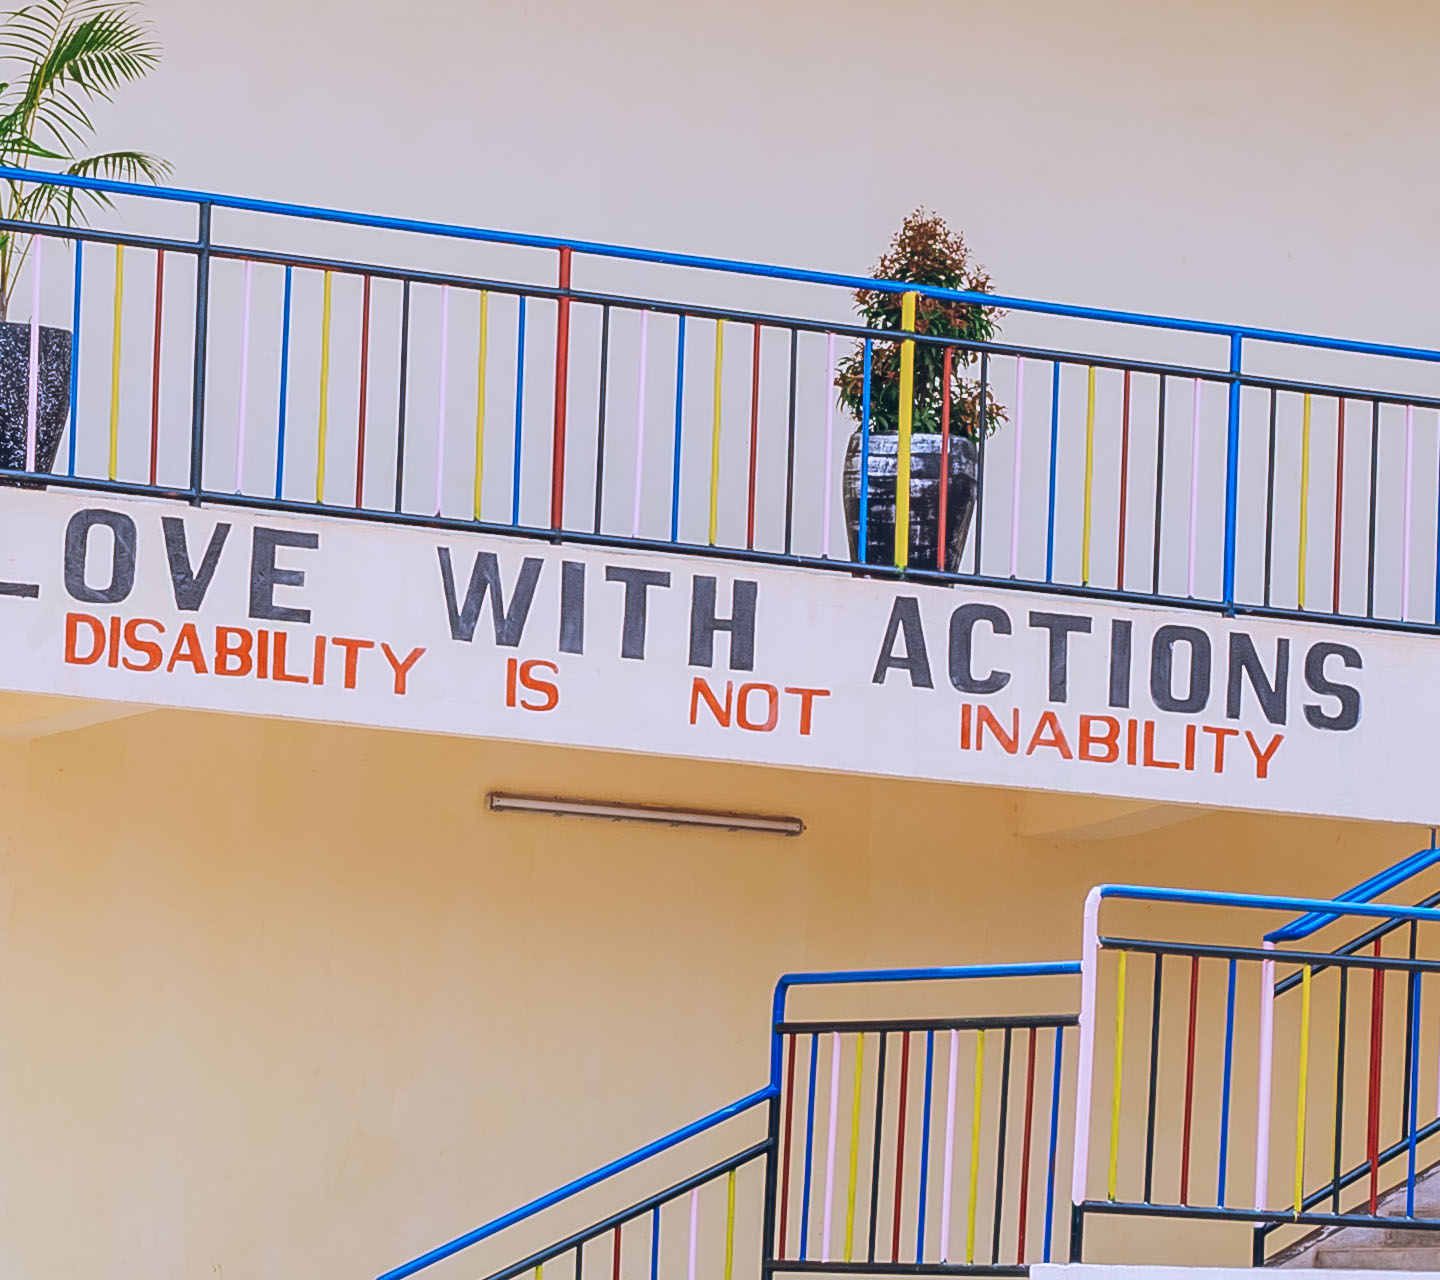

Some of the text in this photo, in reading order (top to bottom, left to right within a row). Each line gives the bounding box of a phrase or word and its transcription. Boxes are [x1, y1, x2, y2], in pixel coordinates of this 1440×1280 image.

[64, 612, 1284, 779] DISABILITY IS NOT INABILITY
[437, 547, 757, 671] WITH
[872, 597, 1363, 731] ACTIONS
